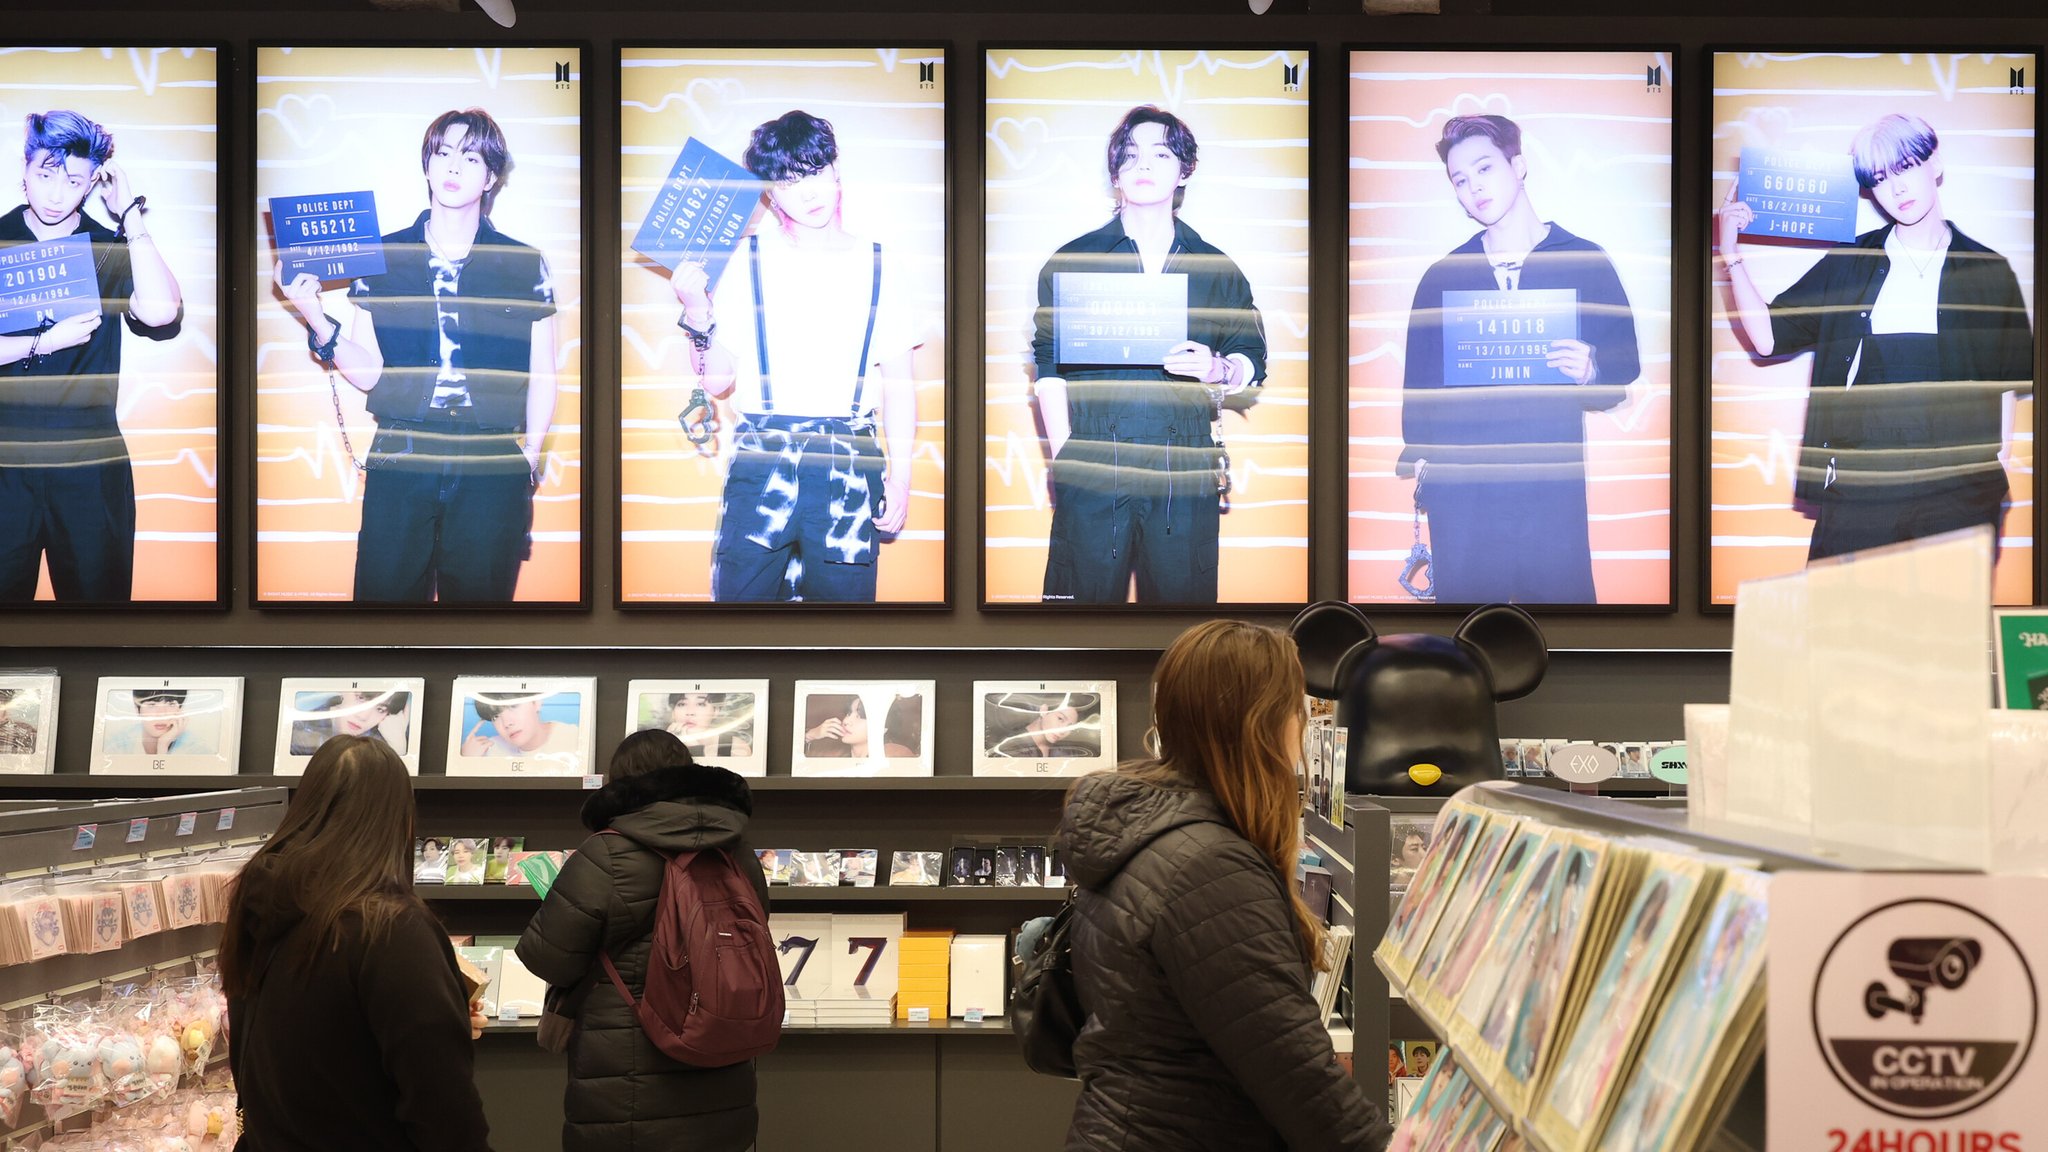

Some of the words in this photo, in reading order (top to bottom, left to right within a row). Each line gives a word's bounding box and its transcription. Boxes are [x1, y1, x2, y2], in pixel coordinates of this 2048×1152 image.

[1764, 175, 1827, 194] 660660
[652, 192, 678, 229] POLICE
[673, 165, 692, 191] DEPT
[297, 201, 328, 213] POLICE
[332, 200, 354, 211] DEPT
[670, 177, 712, 239] 384627
[1762, 200, 1821, 214] 18/2/1994
[301, 218, 356, 236] 655212
[696, 194, 729, 246] 9/3/1993
[1769, 219, 1814, 234] J-HOPE
[719, 213, 744, 246] SUGA
[1, 250, 36, 266] POLICE
[41, 245, 65, 258] DEPT
[307, 242, 359, 256] 4/12/1992
[6, 263, 67, 287] 201904
[327, 262, 344, 276] JIN
[1473, 299, 1512, 310] POLICE
[36, 308, 54, 322] RM
[1476, 318, 1545, 335] 141018
[1123, 346, 1130, 358] V
[1475, 344, 1548, 356] 13/10/1995
[1491, 366, 1530, 379] JIMIN
[153, 760, 165, 770] BE
[512, 762, 524, 772] BE
[1036, 762, 1048, 772] BE
[1570, 755, 1600, 774] EXO
[777, 933, 820, 986] 7
[848, 936, 888, 986] 7
[1872, 1045, 1977, 1076] CCTV
[1870, 1076, 1889, 1090] IN
[1890, 1076, 1984, 1091] OPERATION
[1827, 1128, 2023, 1152] 24HOURS
